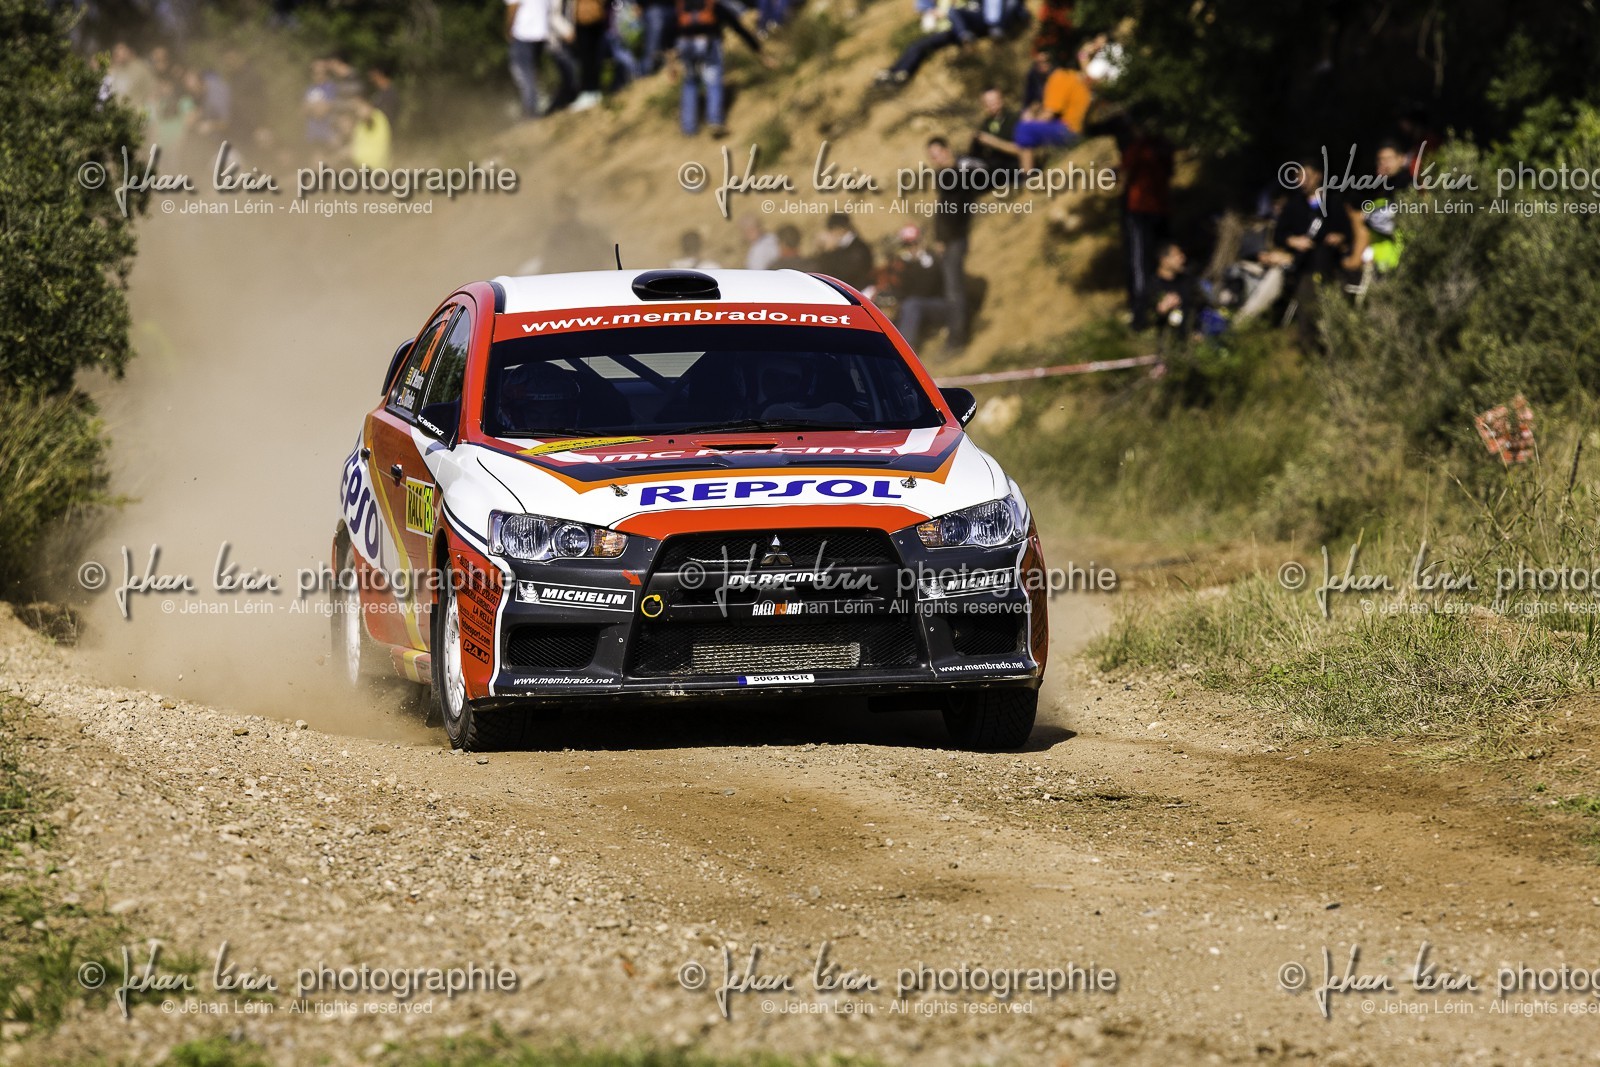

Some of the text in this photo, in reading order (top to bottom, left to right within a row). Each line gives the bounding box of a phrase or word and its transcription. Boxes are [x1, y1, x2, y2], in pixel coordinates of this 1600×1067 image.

[522, 308, 851, 332] www.membrado.net
[640, 479, 902, 506] REPSOL
[407, 484, 423, 528] RACC
[947, 573, 1013, 591] MICHELIN
[541, 588, 627, 605] MICHELIN
[939, 661, 1026, 673] www.membrado.net
[513, 676, 615, 686] www.membrado.net
